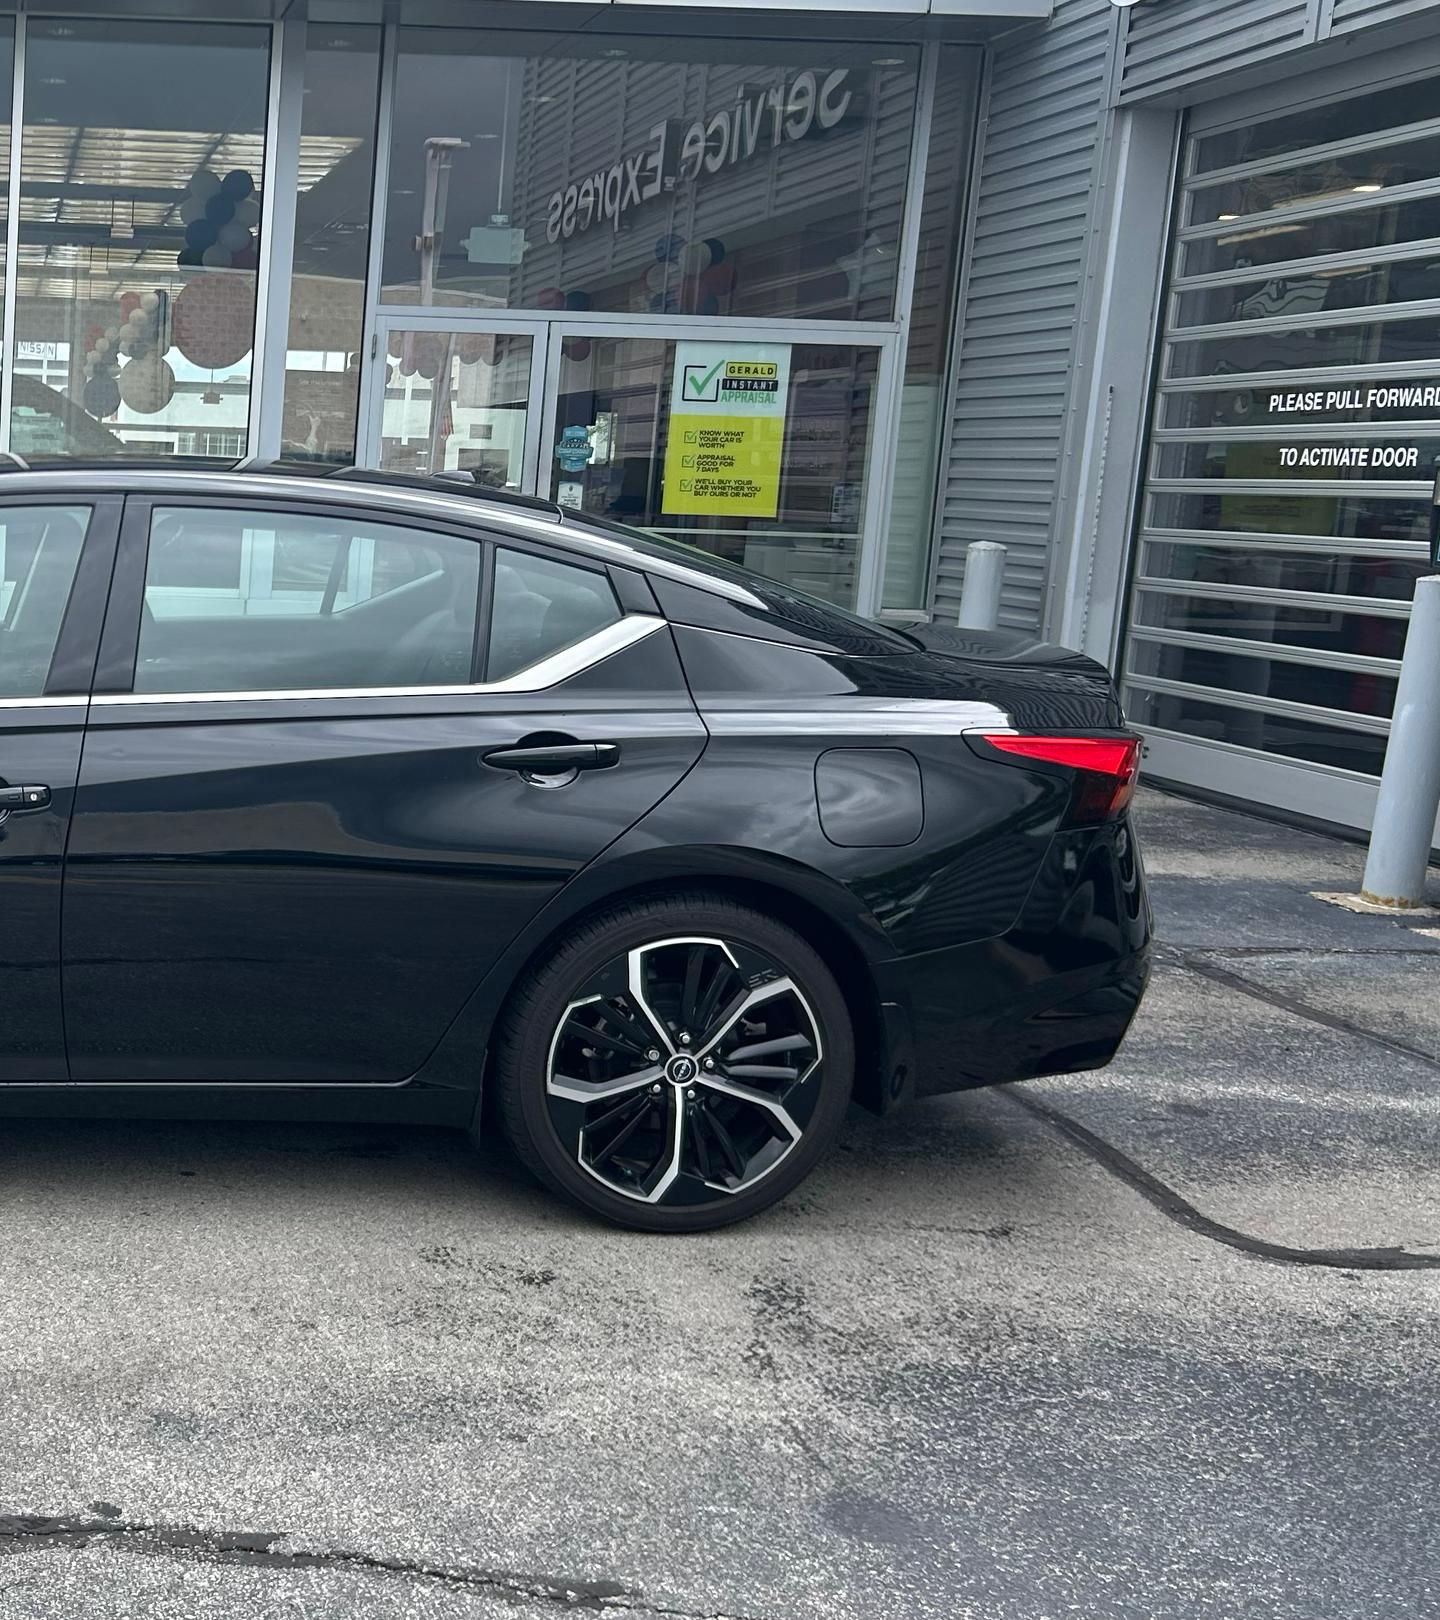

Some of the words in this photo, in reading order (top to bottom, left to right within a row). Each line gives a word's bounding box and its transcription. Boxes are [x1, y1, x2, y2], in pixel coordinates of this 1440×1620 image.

[20, 341, 54, 356] NISSAN
[728, 365, 774, 375] GERALD
[726, 380, 774, 389] INSTANT
[721, 391, 777, 404] APPRAISAL
[1269, 392, 1323, 412] PLEASE
[1326, 390, 1363, 410] PULL
[1279, 448, 1298, 466] TO
[1299, 447, 1368, 467] ACTIVATE
[1371, 447, 1418, 467] DOOR
